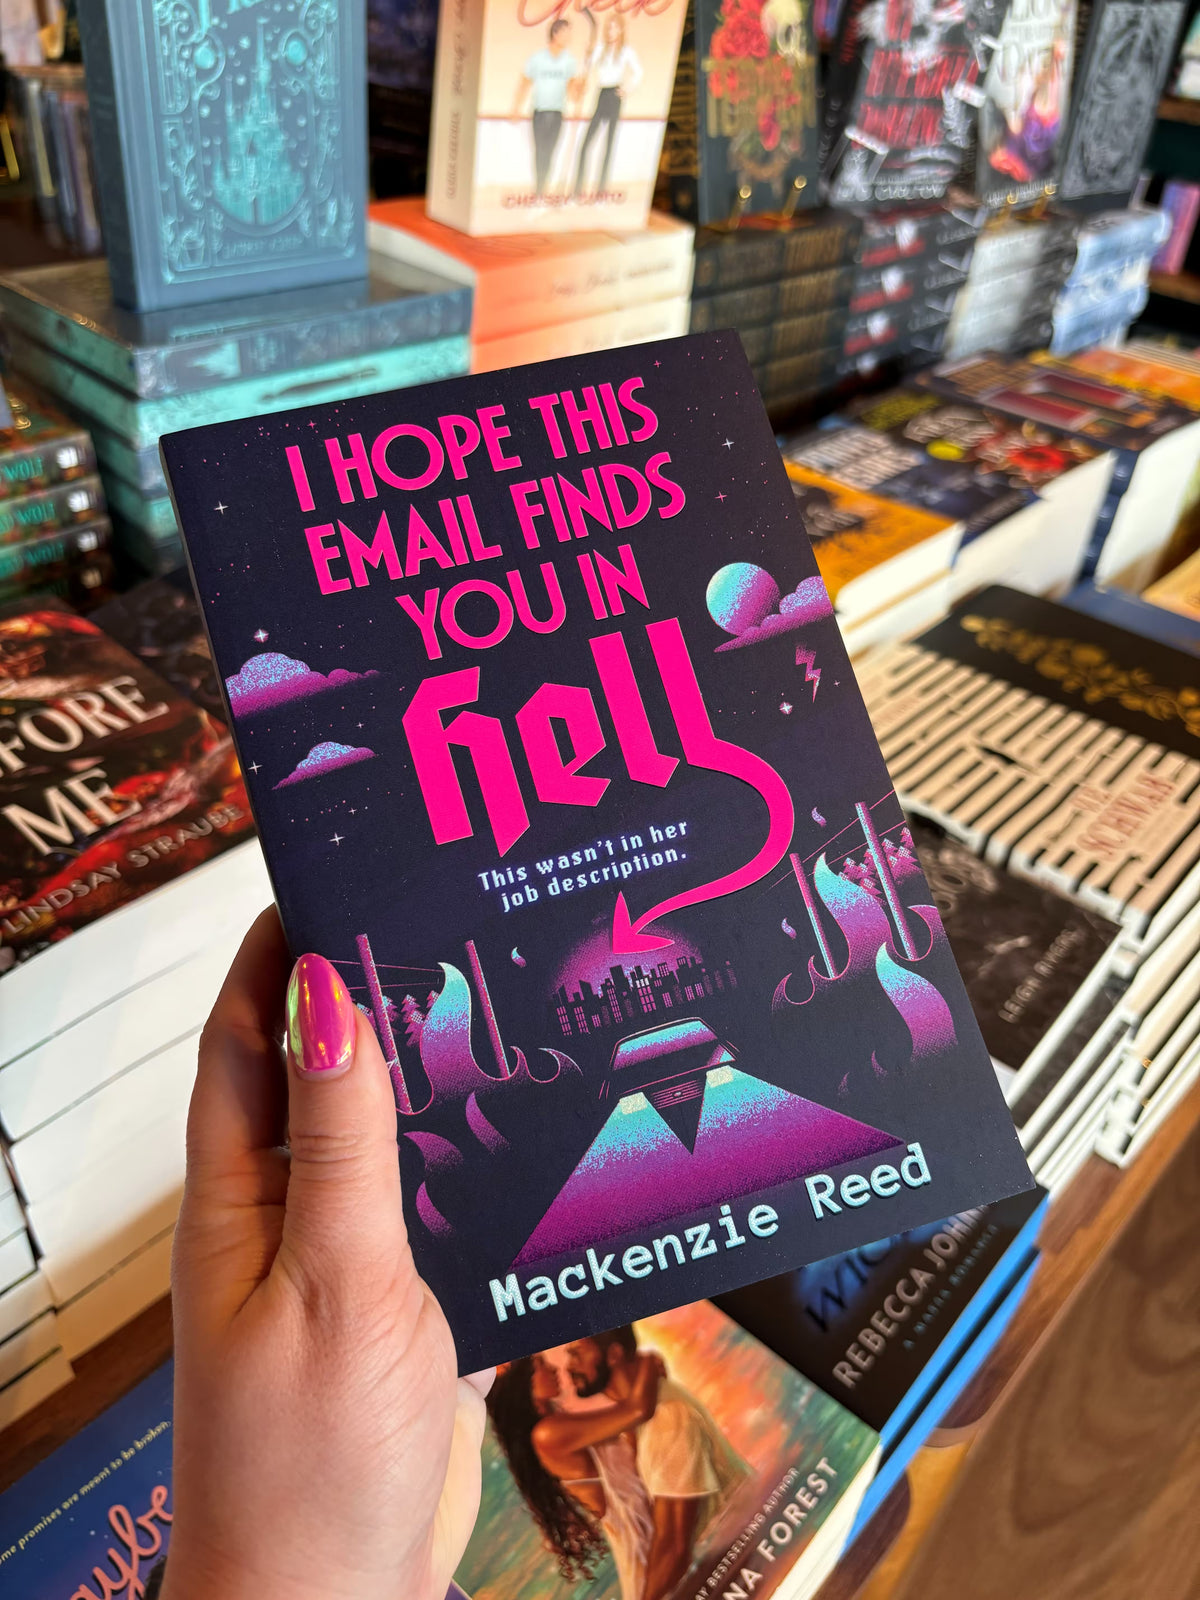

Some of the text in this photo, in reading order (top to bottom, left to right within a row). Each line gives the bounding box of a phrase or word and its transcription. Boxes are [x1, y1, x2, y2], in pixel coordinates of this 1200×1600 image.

[285, 377, 659, 512] I HOPE THIS
[304, 495, 503, 596] EMAIL
[509, 451, 686, 550] FINDS
[395, 544, 651, 661] YOU IN
[0, 675, 169, 774] FORE
[402, 617, 794, 858] hell
[2, 768, 142, 856] ME
[2, 803, 245, 934] LINDSAY STRAUBE
[477, 821, 688, 891] This wasn't in her
[501, 848, 688, 913] job description.
[488, 1142, 932, 1323] Mackenzie Reed
[832, 1268, 936, 1389] REBECCA
[18, 1508, 62, 1550] promises
[62, 1493, 79, 1510] are
[80, 1467, 111, 1496] meant
[110, 1458, 123, 1471] to
[121, 1447, 136, 1461] be
[706, 1512, 766, 1587] BESTSELLING
[763, 1467, 800, 1515] AUTHOR
[756, 1457, 838, 1563] FOREST
